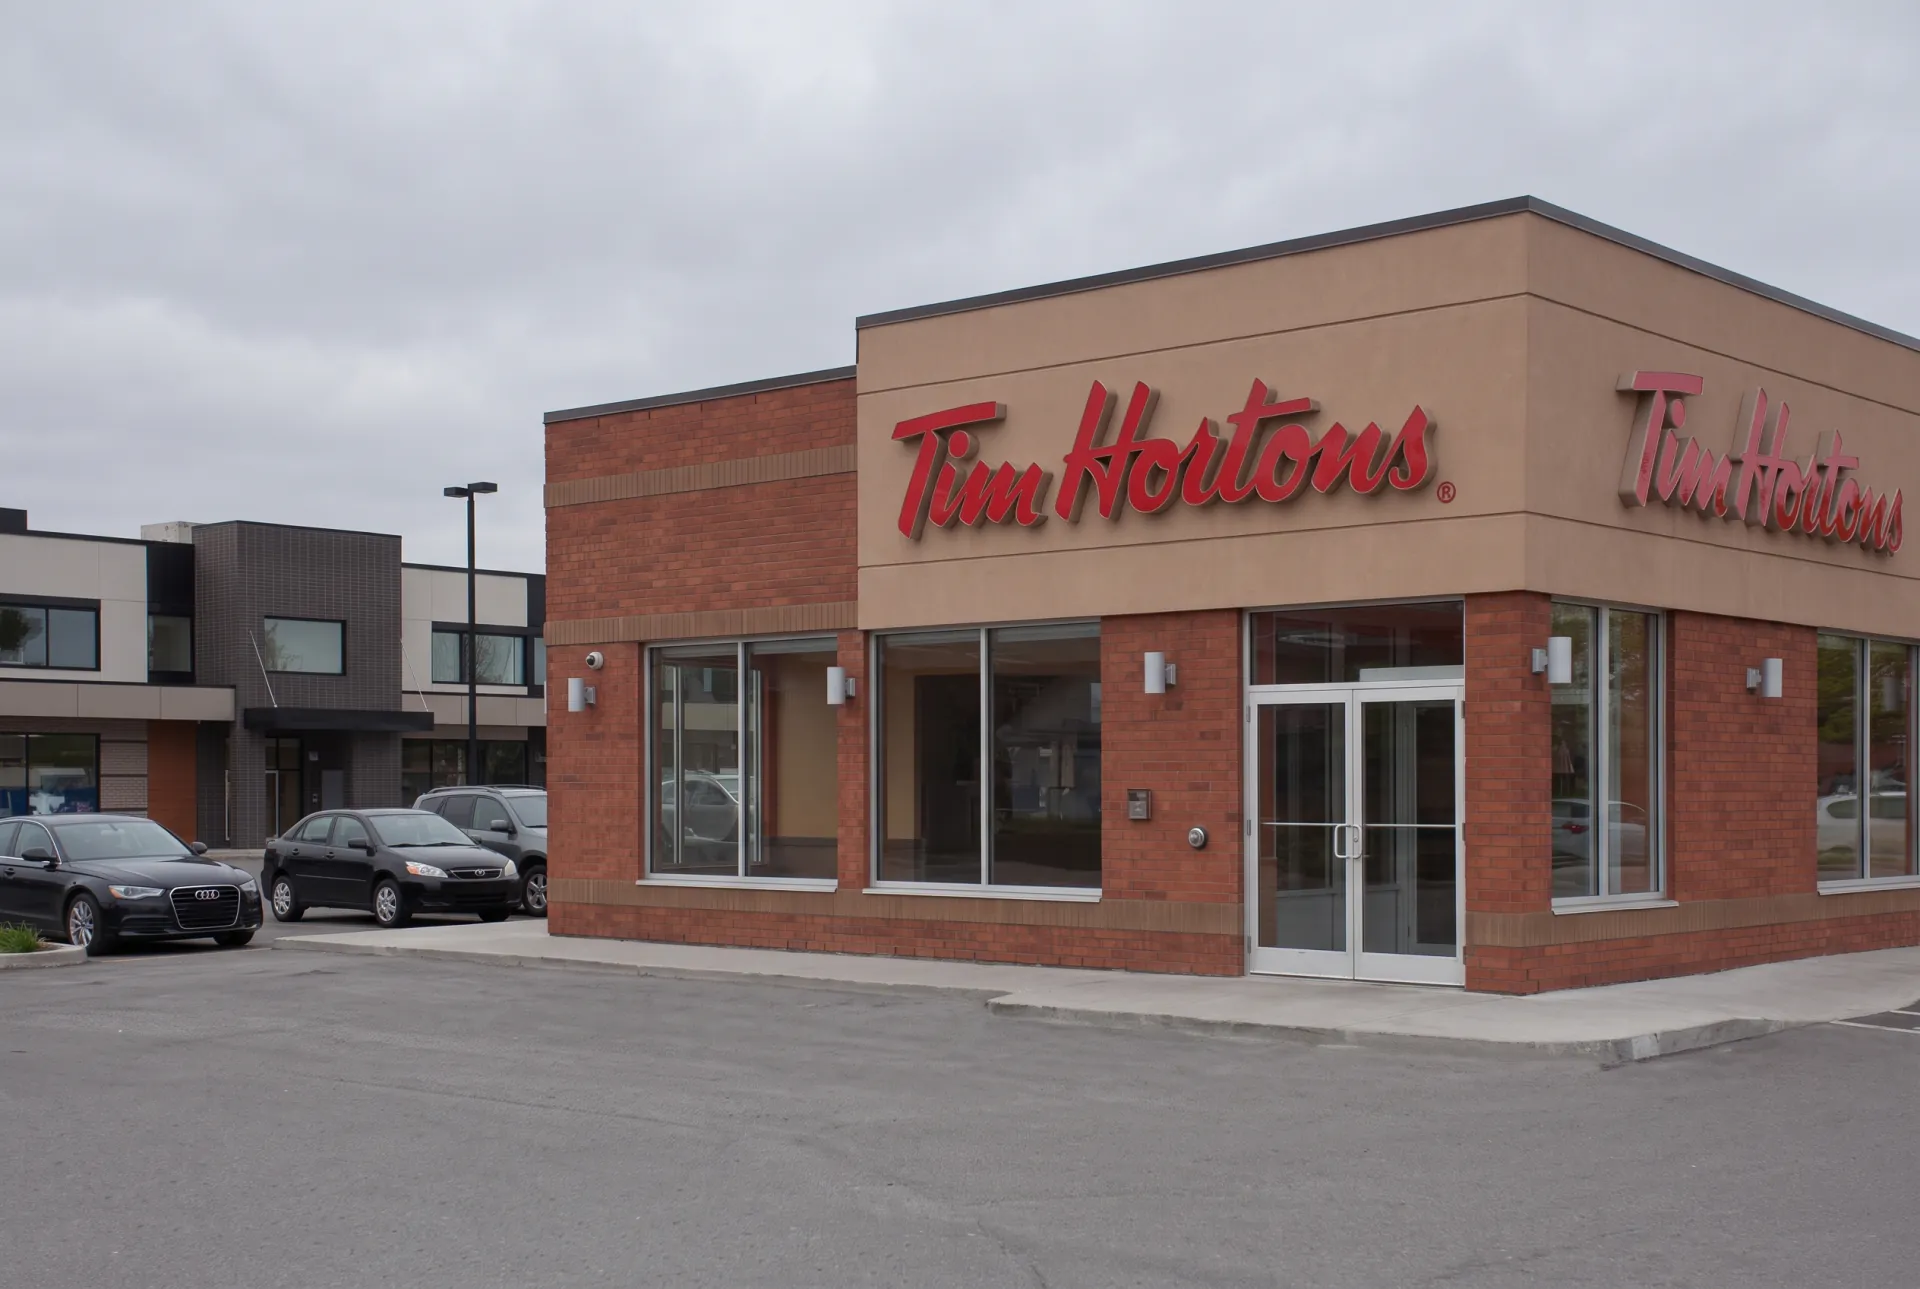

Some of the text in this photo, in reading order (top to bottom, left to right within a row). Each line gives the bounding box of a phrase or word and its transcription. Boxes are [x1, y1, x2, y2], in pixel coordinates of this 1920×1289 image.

[891, 400, 1047, 540] Tim
[1054, 377, 1431, 521] Hortons
[1624, 370, 1904, 554] Tim Hortons
